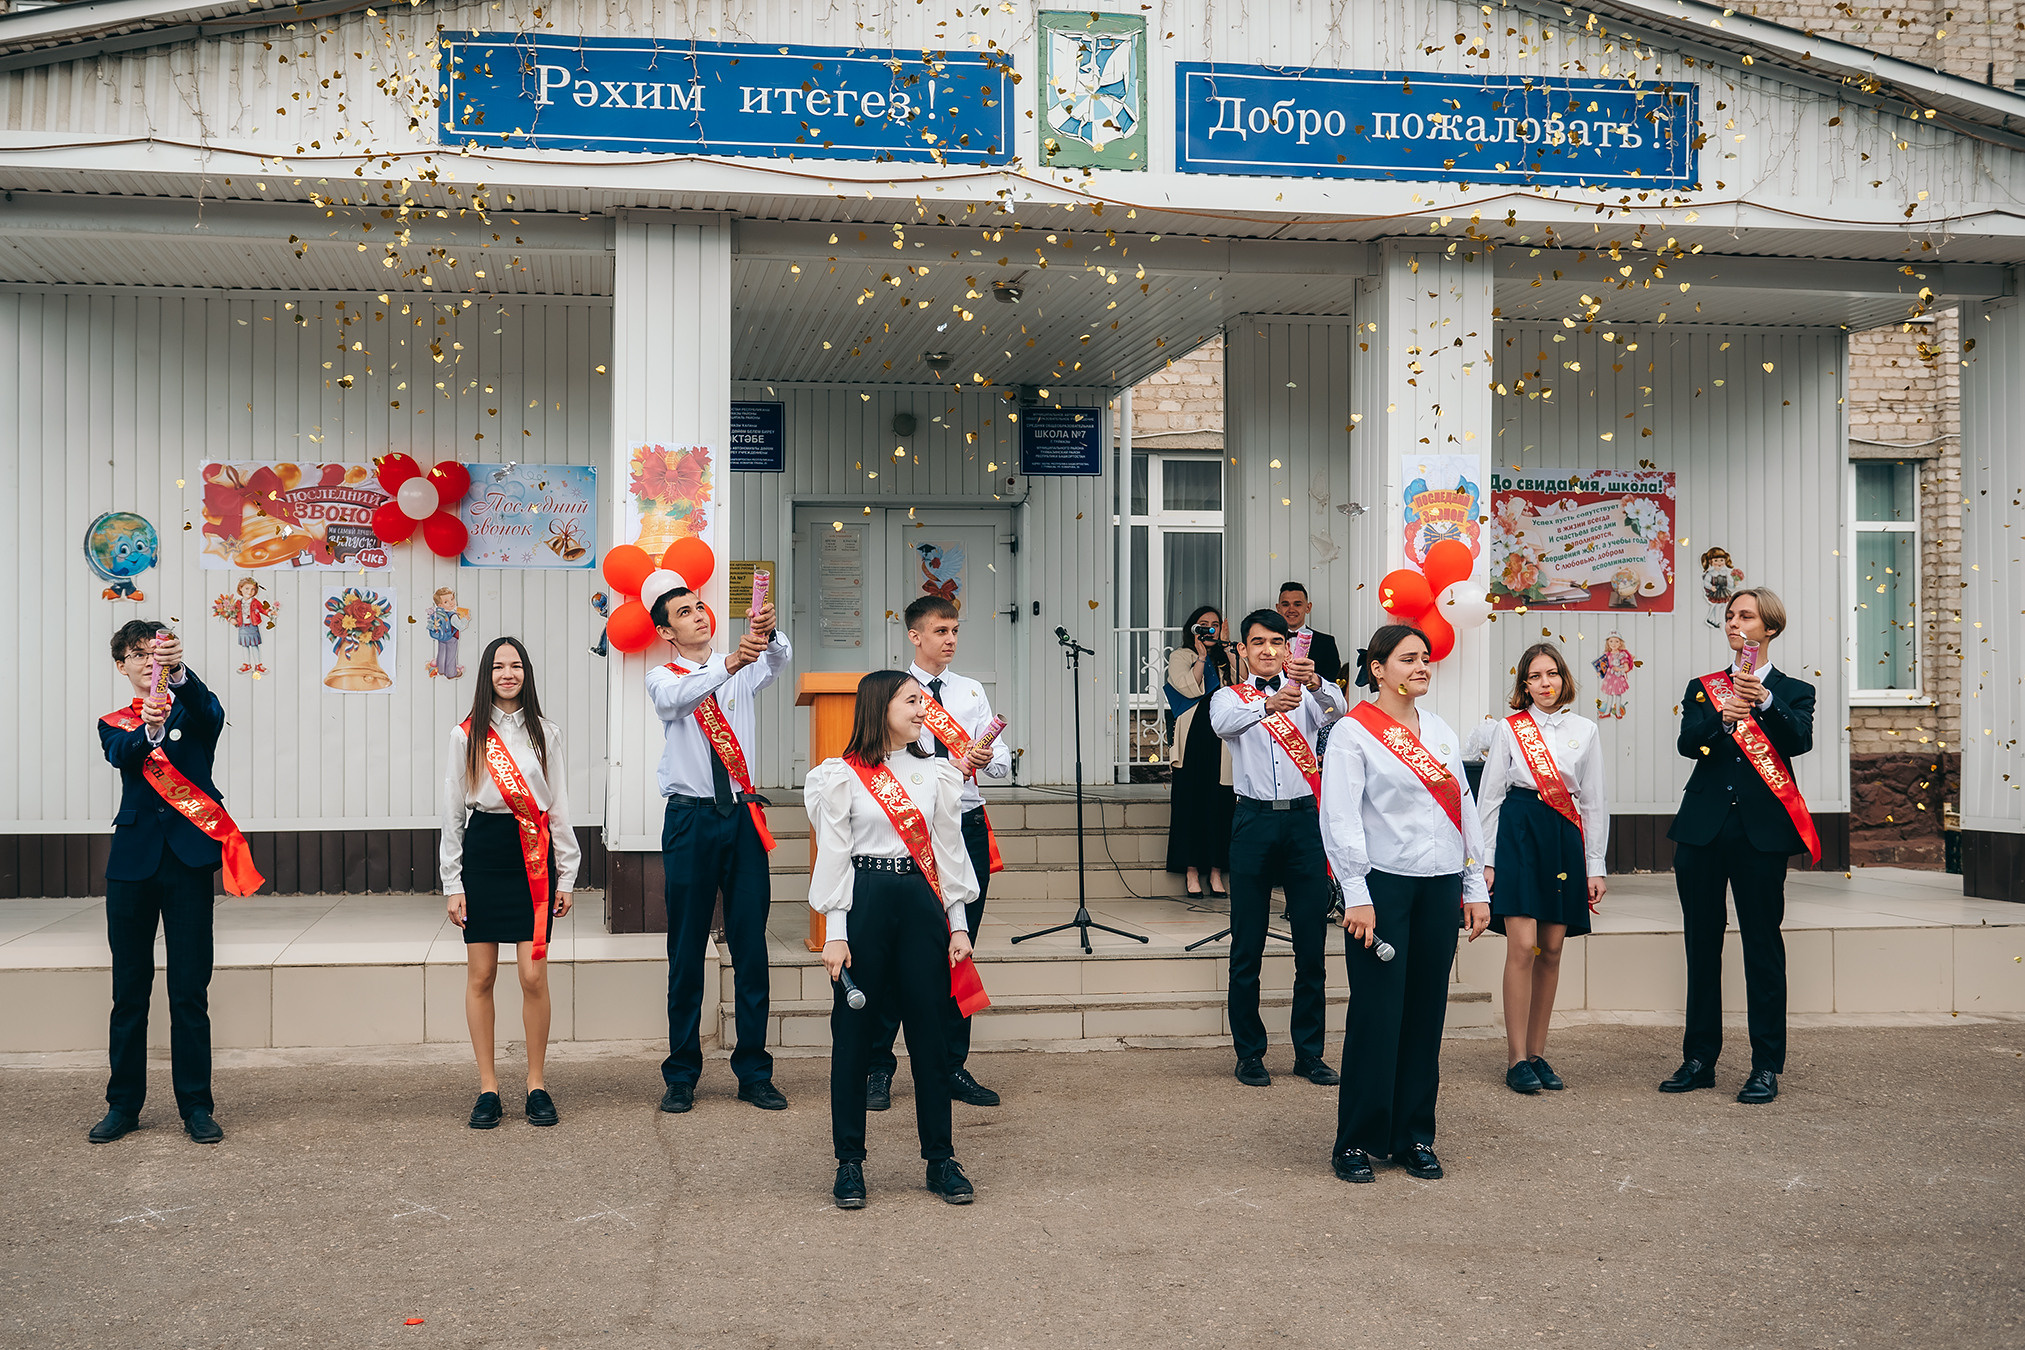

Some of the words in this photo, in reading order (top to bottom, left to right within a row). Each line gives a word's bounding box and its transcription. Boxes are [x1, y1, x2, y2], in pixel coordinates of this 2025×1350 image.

[536, 64, 706, 113] Рәхим
[1209, 97, 1347, 145] Добро
[1372, 110, 1662, 149] пожаловать!
[730, 434, 765, 443] КТӘБЕ
[1034, 430, 1069, 438] ШКОЛА
[1071, 430, 1086, 439] №7
[1491, 474, 1512, 492] До
[1608, 480, 1663, 493] школа!
[286, 489, 380, 506] ПОСЛЕДНИЙ
[470, 492, 589, 515] Последний
[1555, 515, 1575, 524] пусть
[1576, 503, 1619, 518] сопутствует
[1563, 522, 1586, 532] жизни
[1587, 514, 1610, 525] всегда
[471, 517, 533, 536] звонок
[1556, 529, 1589, 542] счастьем
[1603, 521, 1616, 529] дни
[1566, 531, 1614, 548] аполняются,
[361, 552, 384, 564] LIKE
[1541, 550, 1580, 563] вершения
[1608, 537, 1631, 548] учебы
[1633, 537, 1648, 545] года
[1561, 556, 1597, 570] любовью,
[1598, 549, 1624, 560] добром
[1592, 556, 1646, 571] вспоминаются!
[711, 731, 731, 743] 9
[1746, 742, 1768, 755] 9
[1289, 744, 1316, 773] 202
